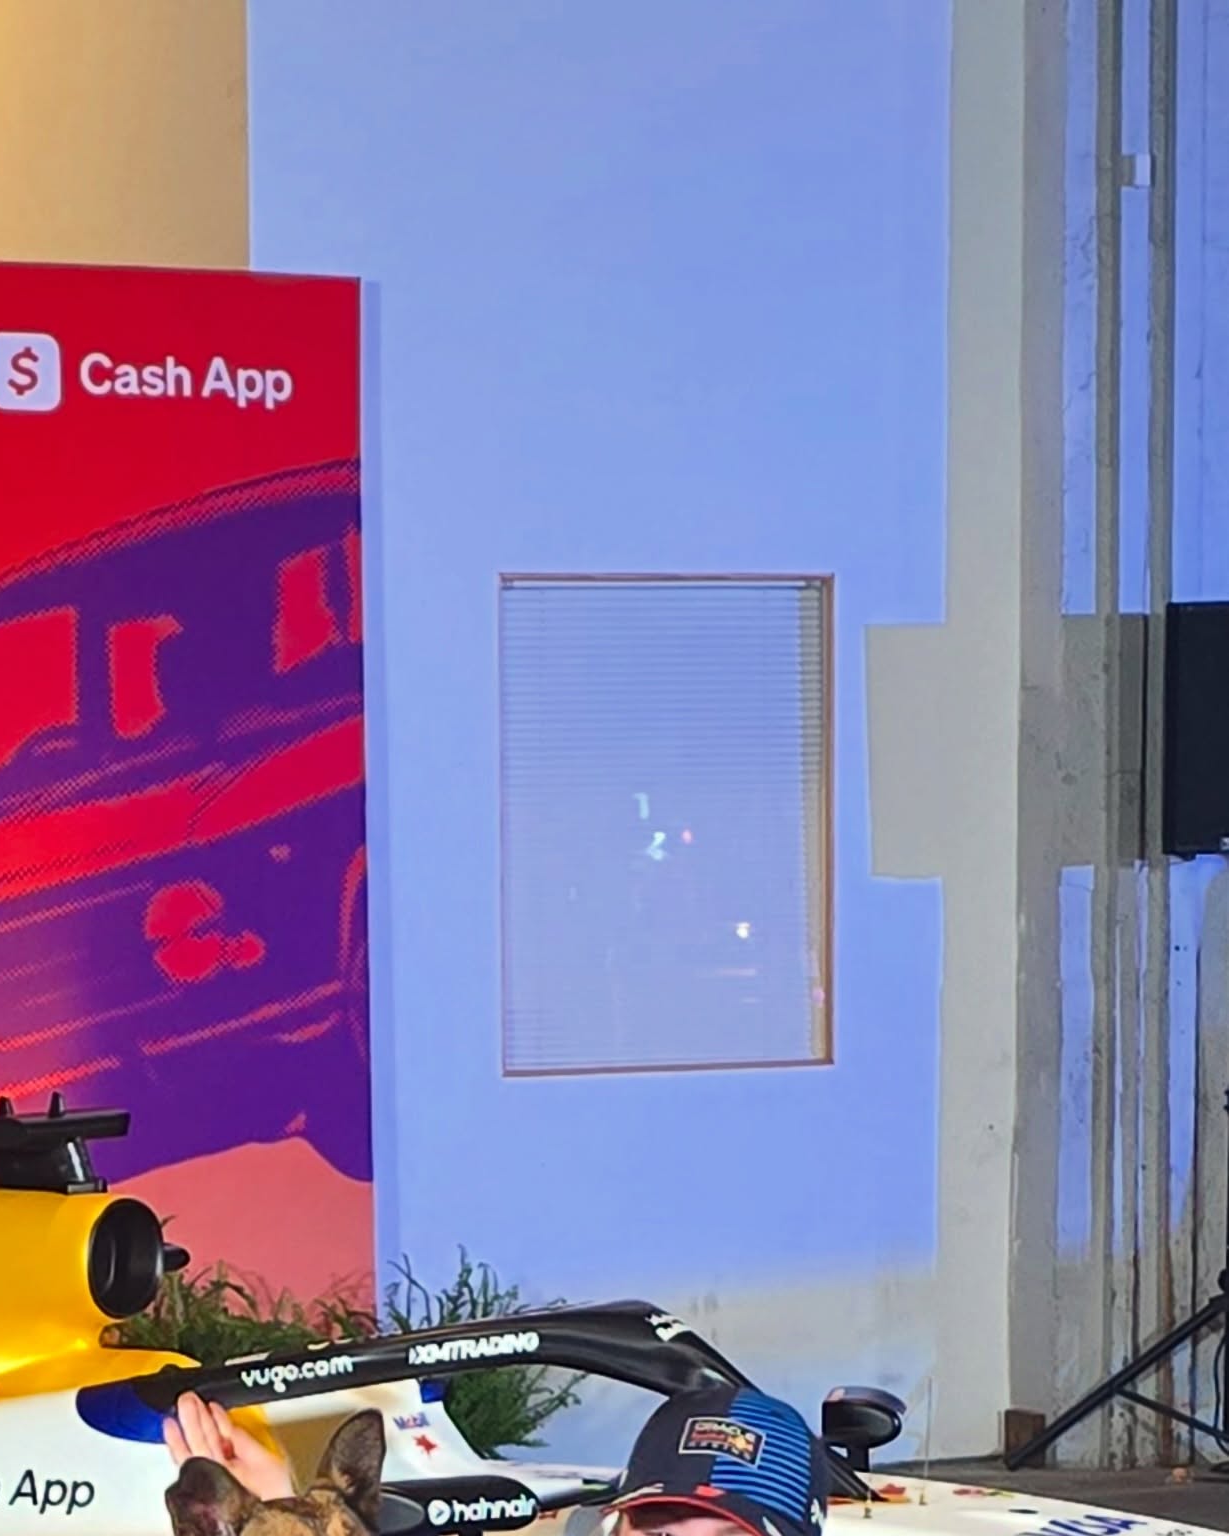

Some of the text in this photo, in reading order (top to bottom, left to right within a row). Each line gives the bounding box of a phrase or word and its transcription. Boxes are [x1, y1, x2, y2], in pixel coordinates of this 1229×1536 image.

[79, 353, 194, 401] Cash
[200, 356, 293, 410] App
[8, 1470, 96, 1515] App
